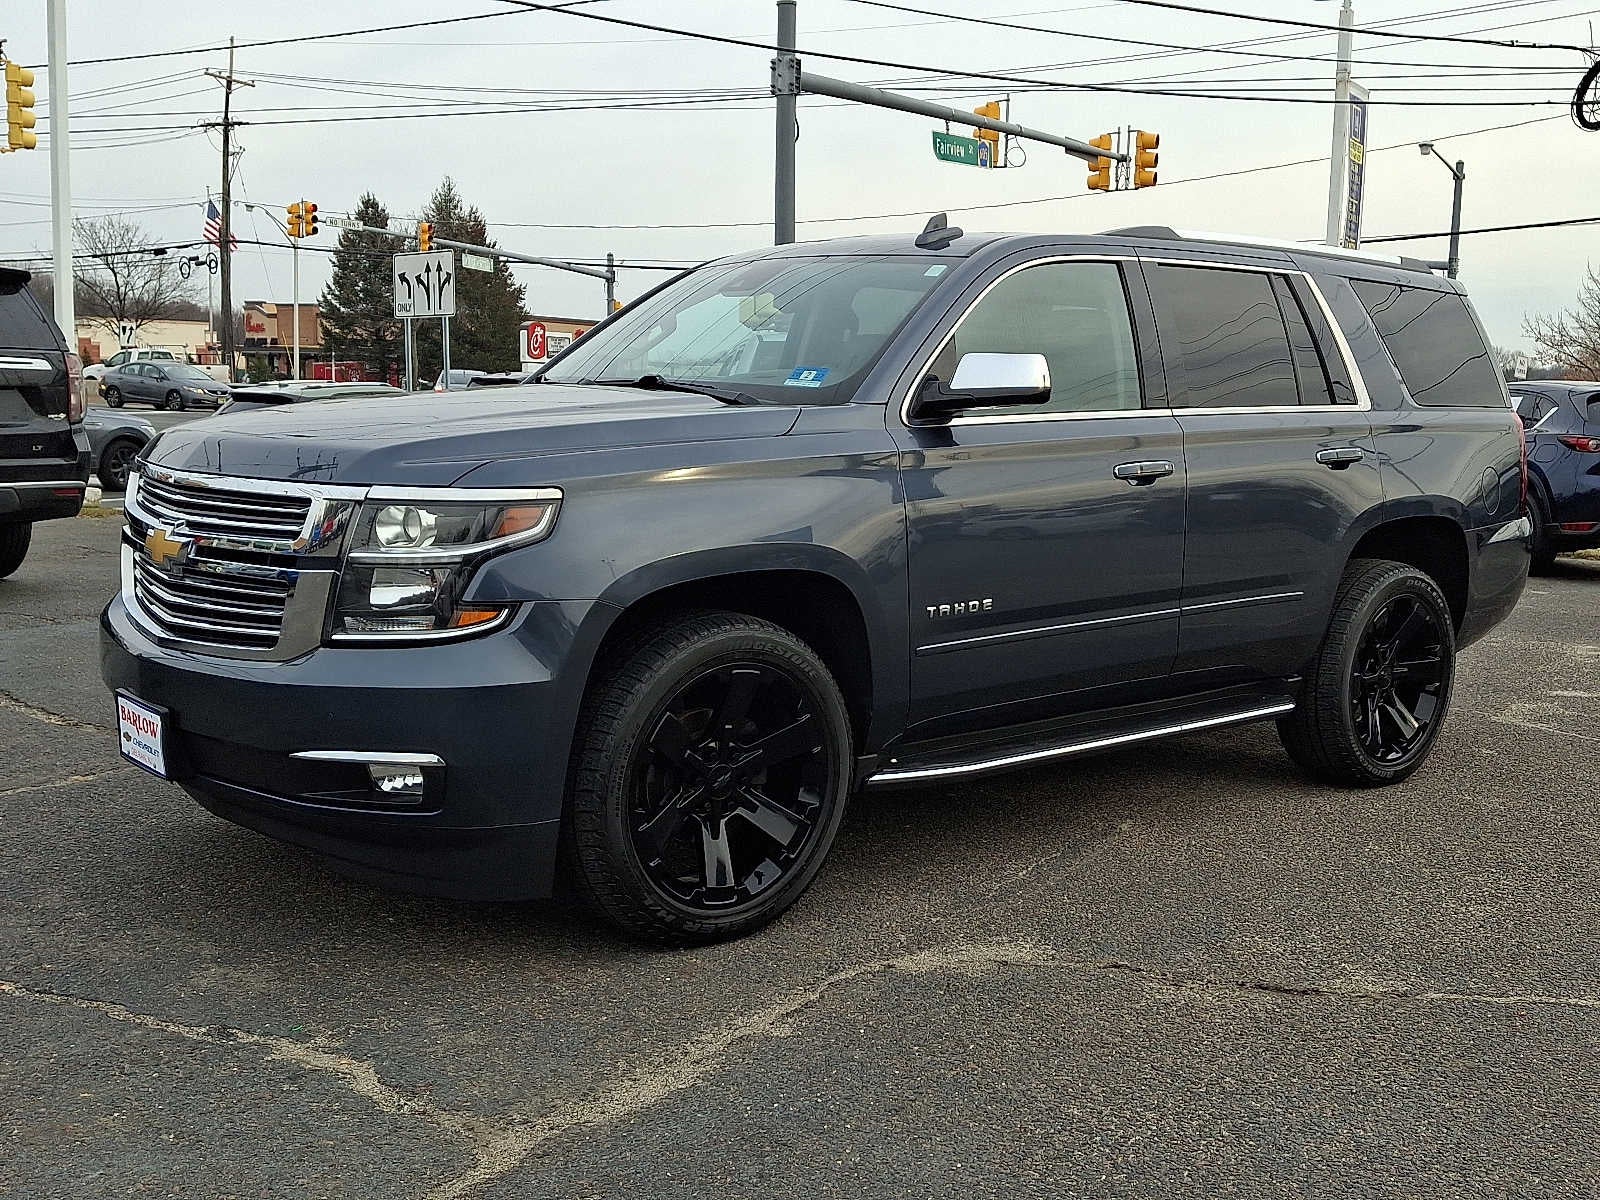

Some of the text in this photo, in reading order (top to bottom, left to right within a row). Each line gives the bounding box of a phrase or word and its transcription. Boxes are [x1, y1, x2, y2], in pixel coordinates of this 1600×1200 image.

[936, 137, 965, 158] Fairview
[329, 217, 338, 226] NO
[397, 302, 413, 313] ONLY
[926, 598, 993, 619] TAHOE
[120, 704, 159, 739] BARLOW
